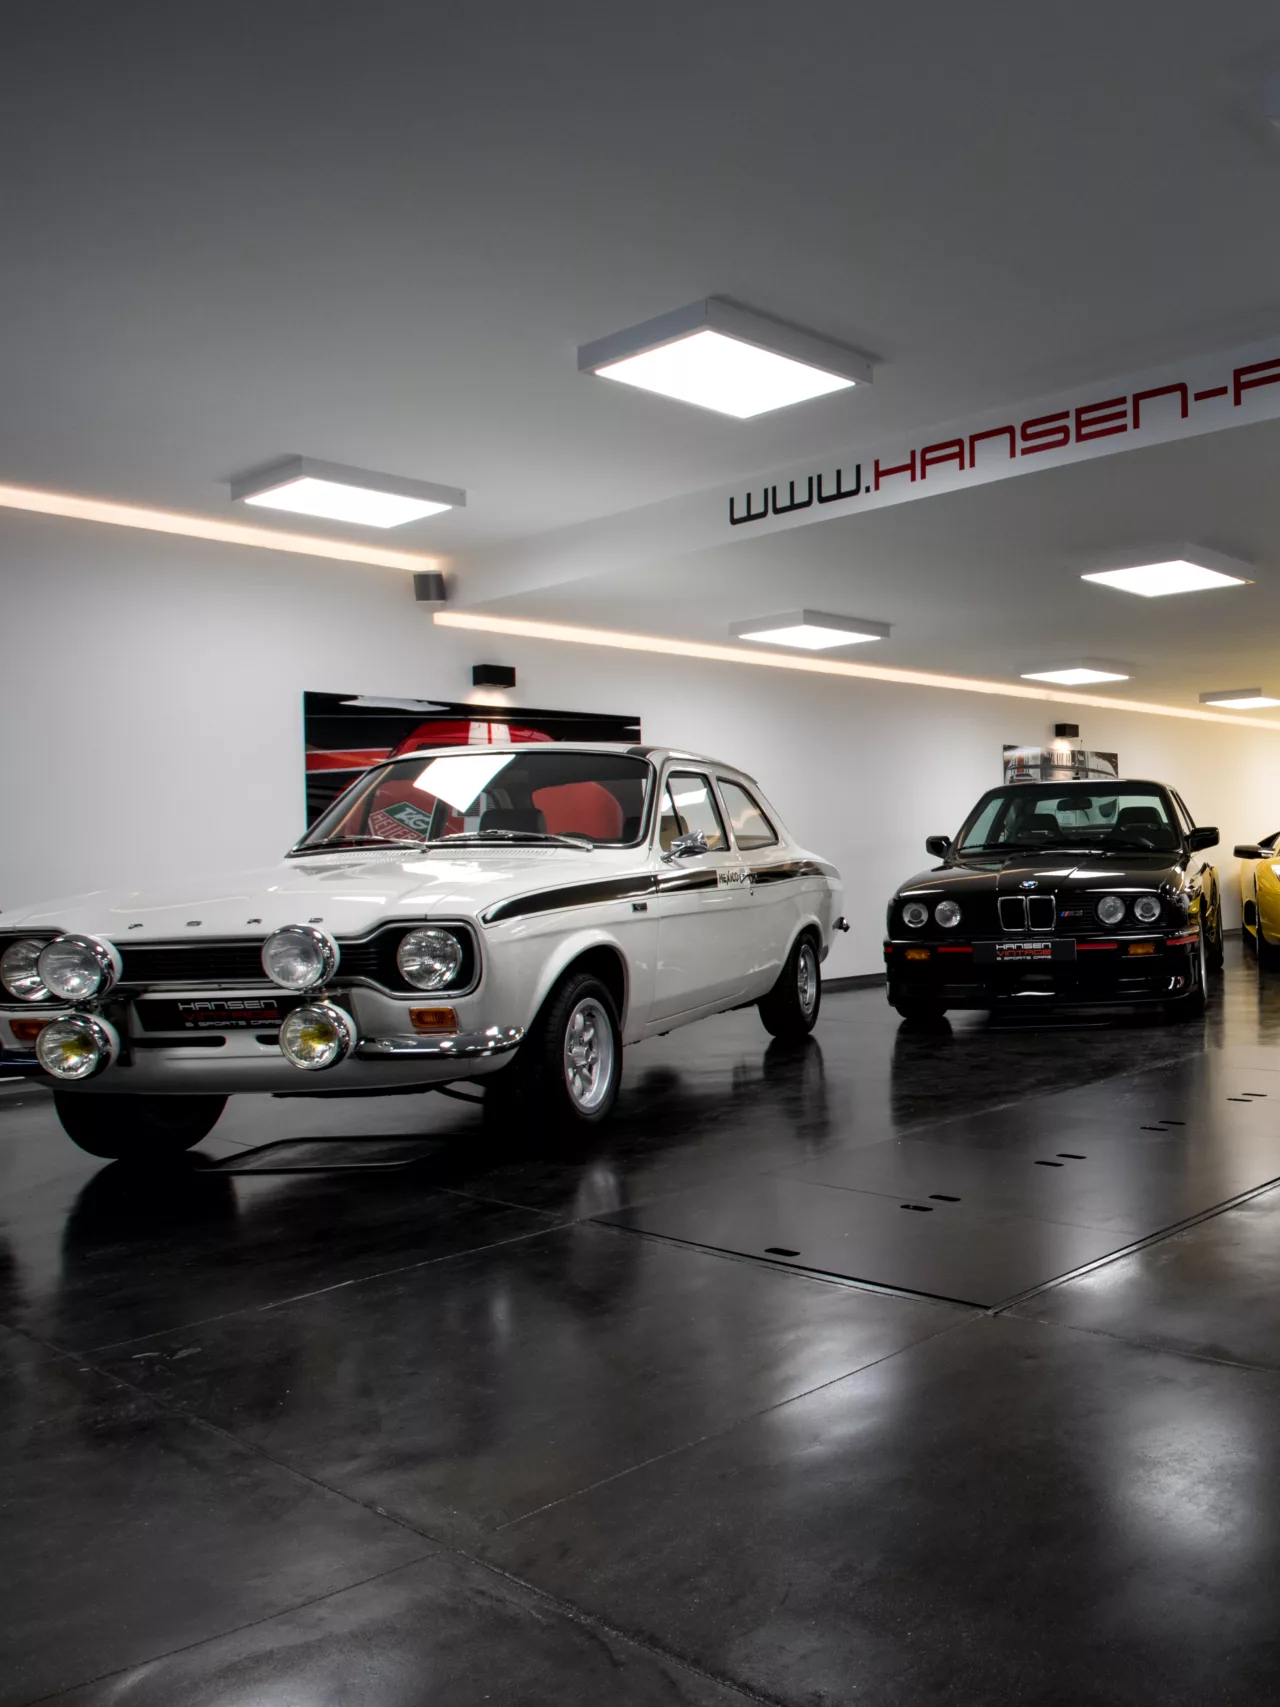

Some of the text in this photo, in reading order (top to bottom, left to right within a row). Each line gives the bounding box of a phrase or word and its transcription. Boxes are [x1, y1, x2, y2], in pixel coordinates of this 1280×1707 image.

[394, 806, 432, 830] TAG
[372, 813, 418, 841] HEUER
[996, 942, 1052, 950] HANSEN
[997, 948, 1052, 957] VINTAGE
[178, 999, 278, 1011] HANSEN
[181, 1010, 281, 1021] VINTAGE
